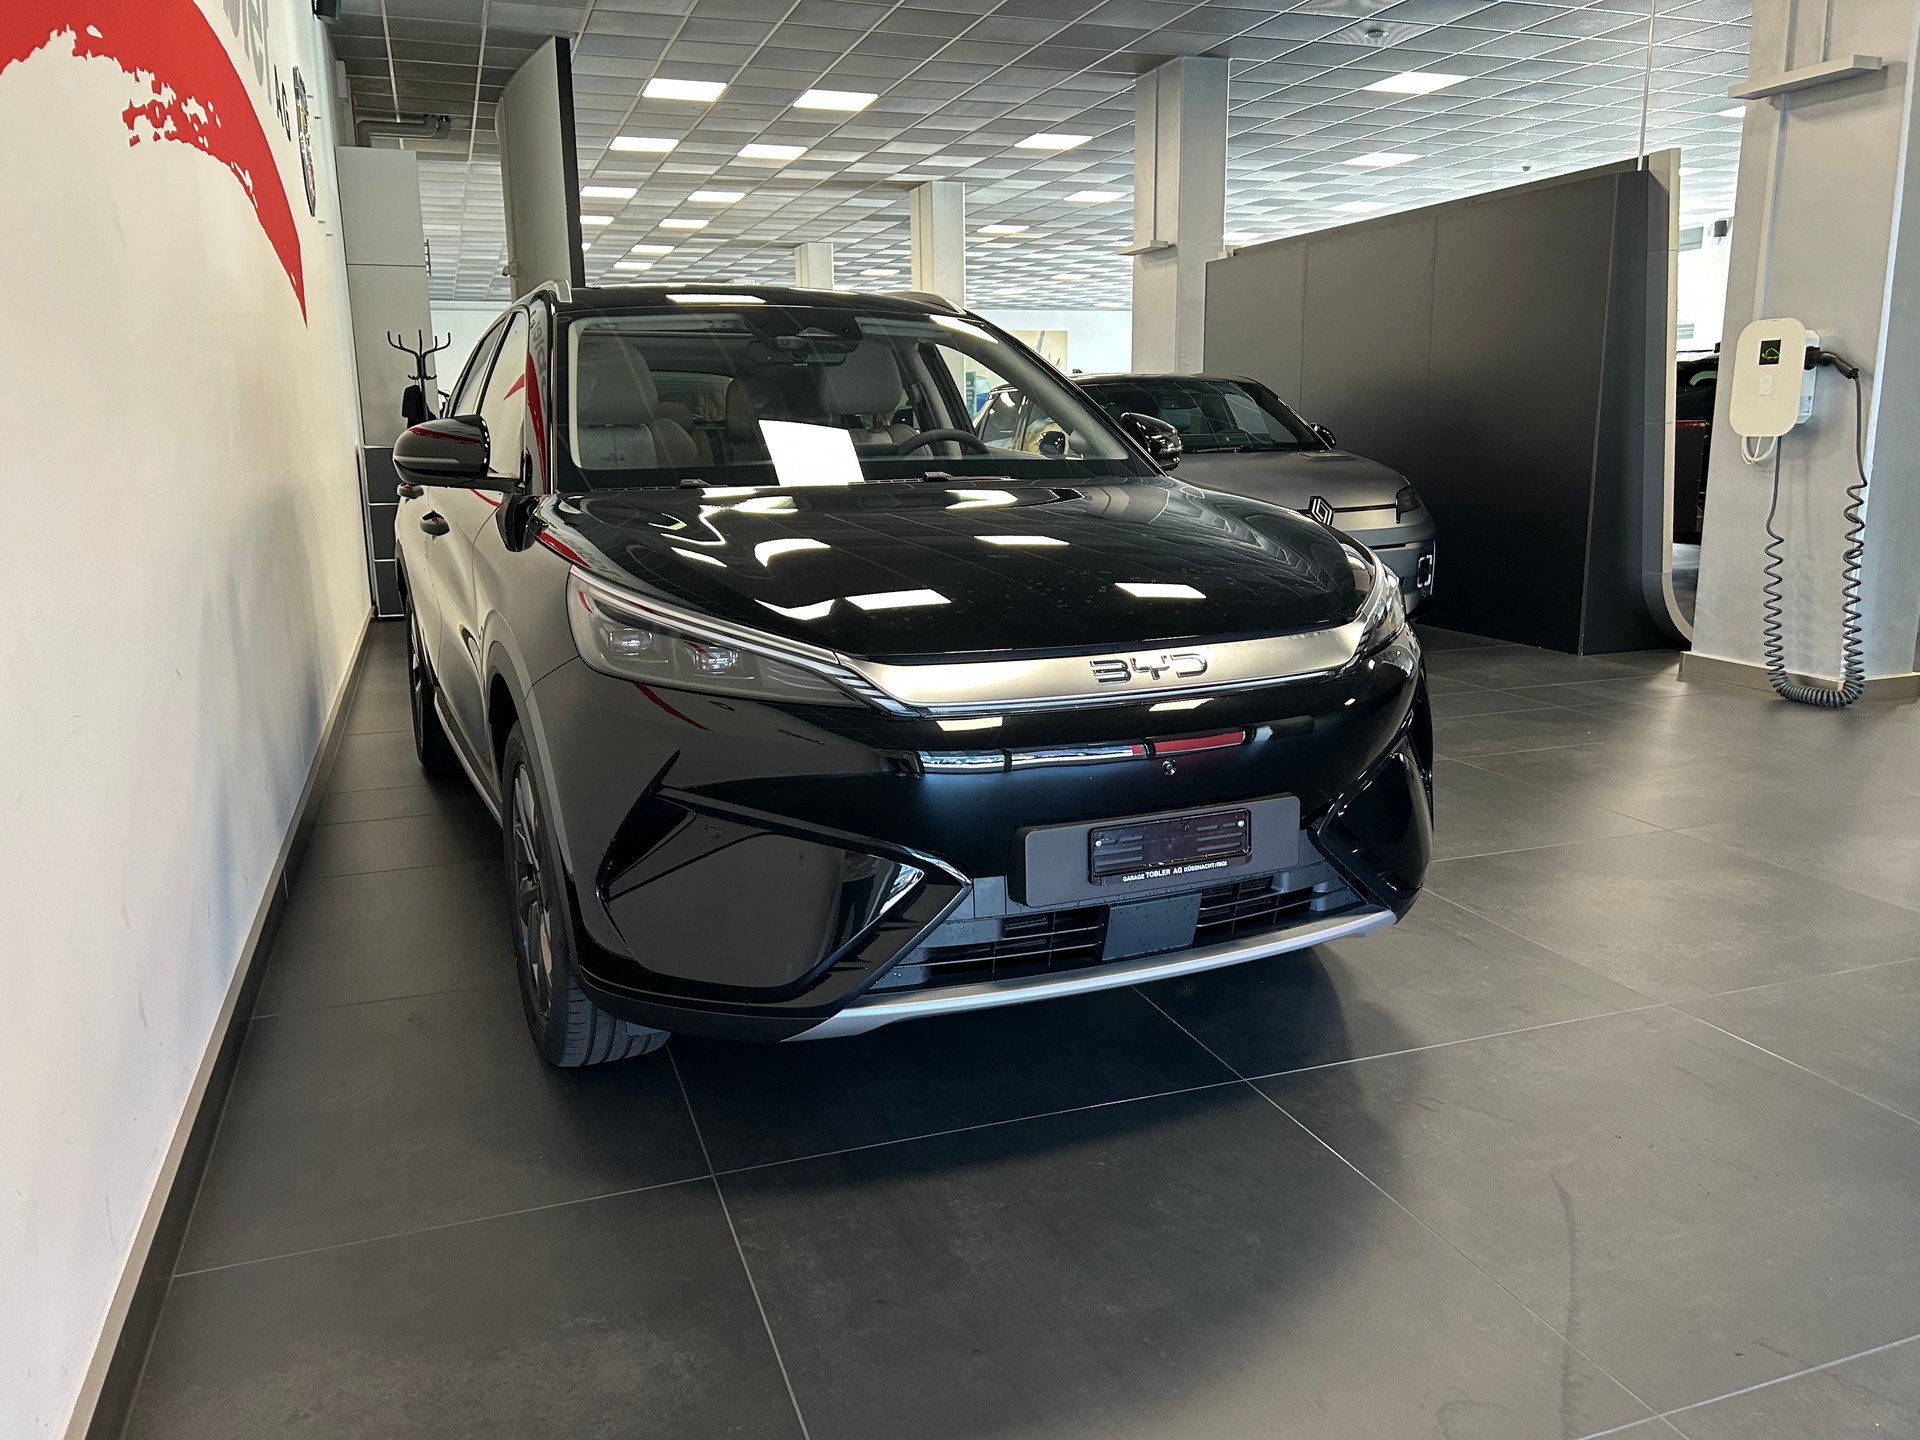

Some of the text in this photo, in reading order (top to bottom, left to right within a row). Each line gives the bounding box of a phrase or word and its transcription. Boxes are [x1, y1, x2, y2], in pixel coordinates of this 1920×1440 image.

[274, 63, 292, 142] AG
[1090, 653, 1208, 685] BYD
[1122, 873, 1145, 882] GARAGE
[1145, 869, 1171, 879] TOBLER
[1173, 866, 1183, 874] AG
